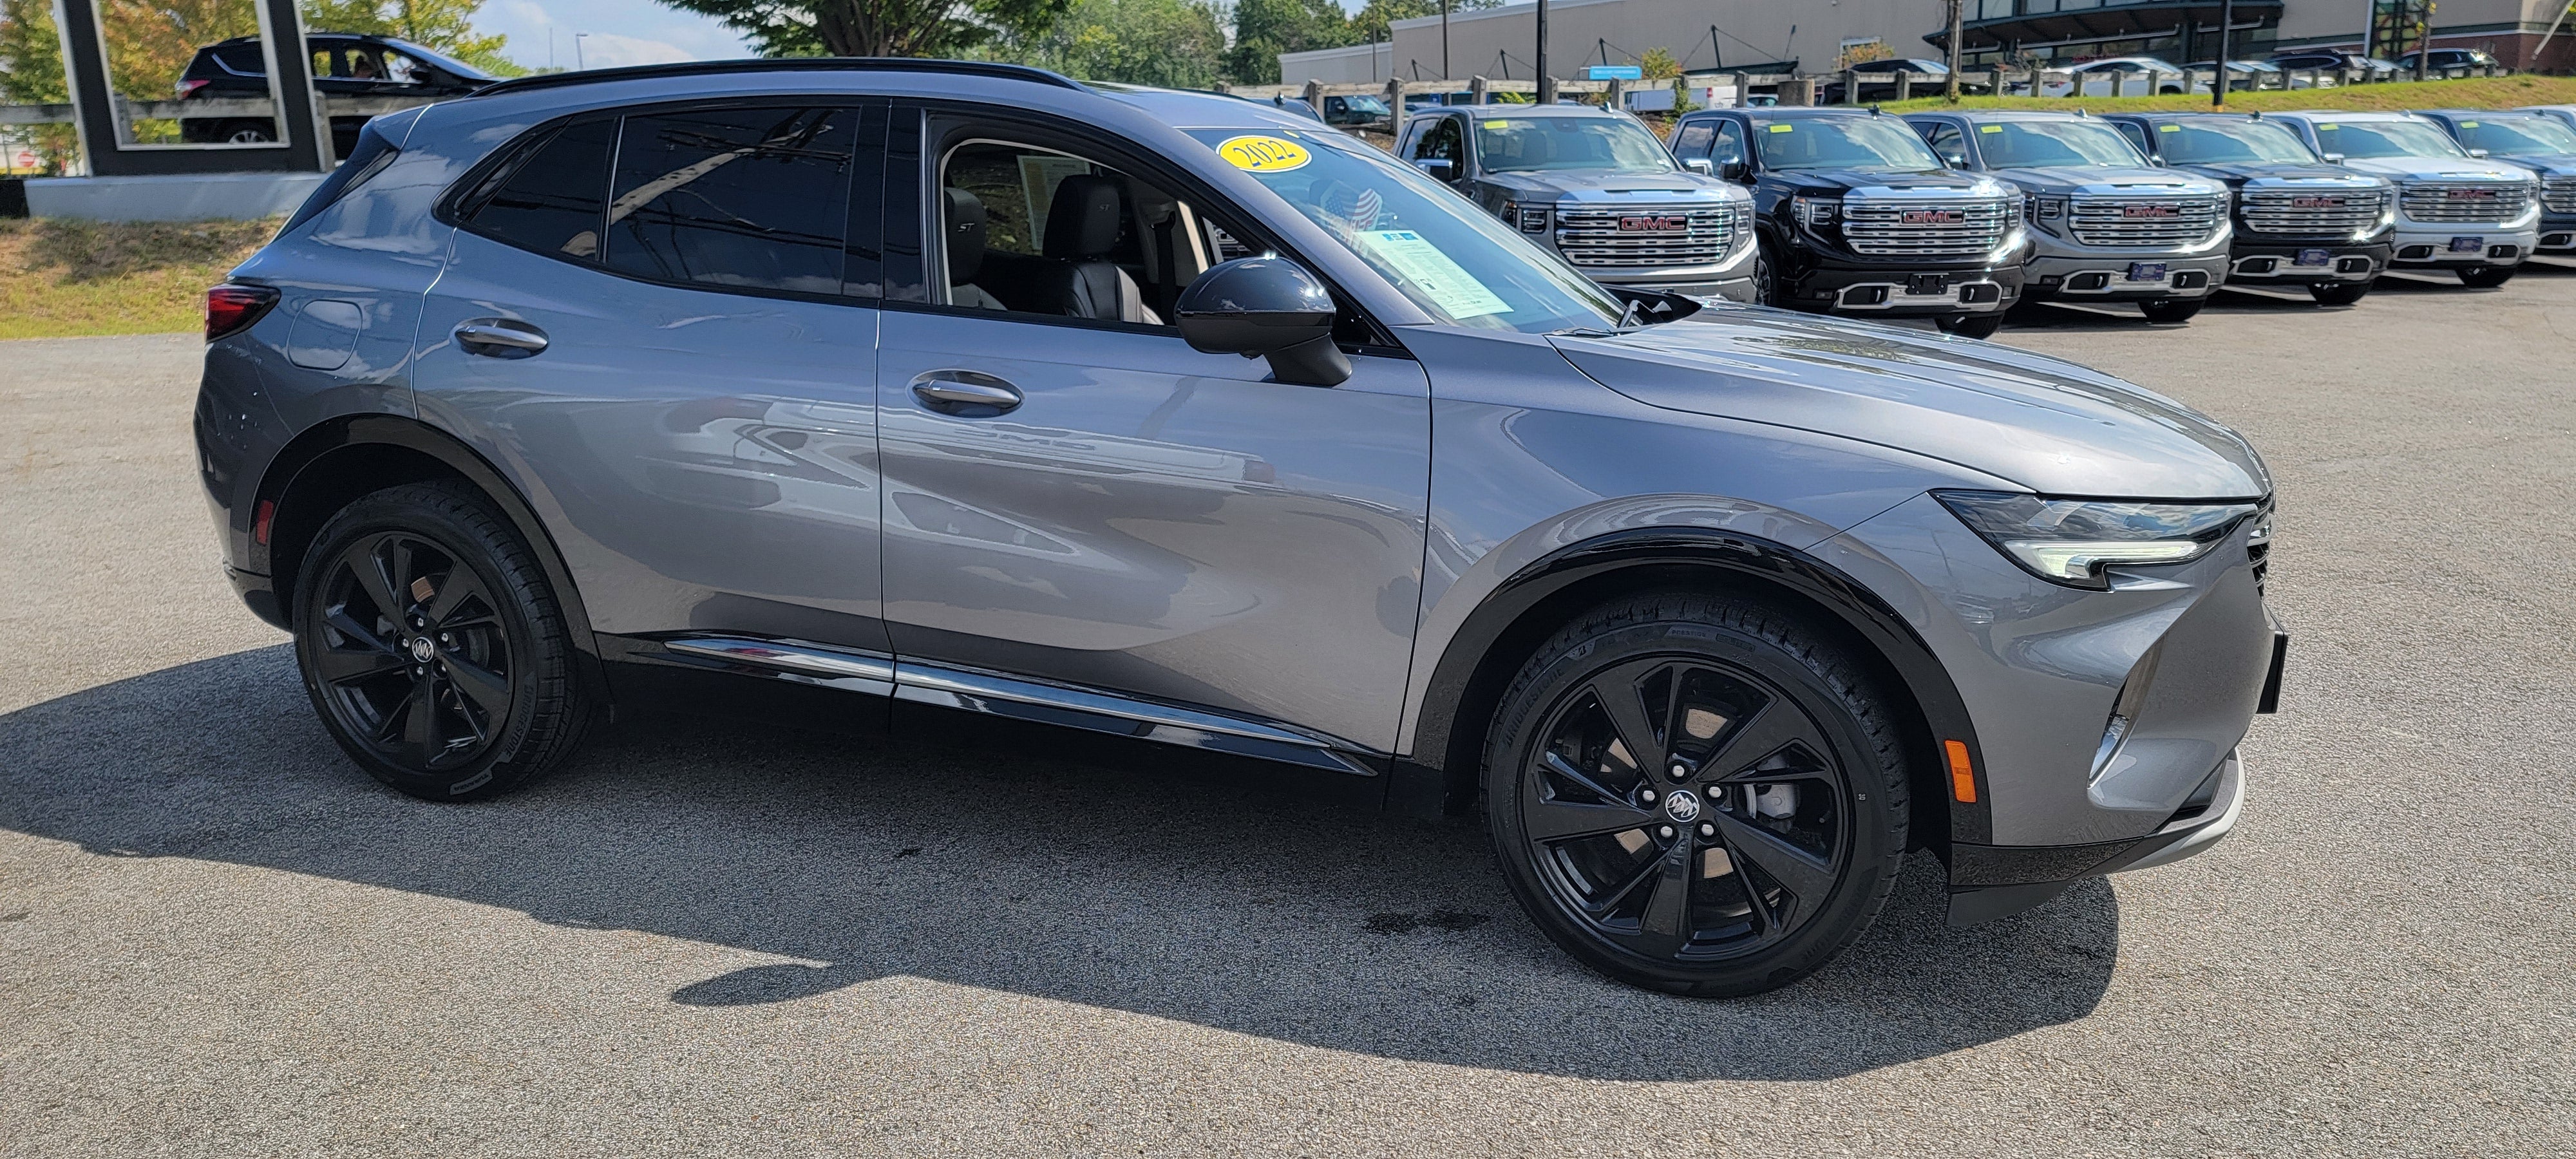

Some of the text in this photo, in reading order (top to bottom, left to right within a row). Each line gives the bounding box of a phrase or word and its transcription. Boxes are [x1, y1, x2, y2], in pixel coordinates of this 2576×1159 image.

[1233, 140, 1296, 167] 2022
[2449, 190, 2496, 200] GMC
[2294, 198, 2344, 208] GMC
[1904, 211, 1963, 223] GMC
[2126, 206, 2179, 217] GMC
[957, 222, 976, 232] ST
[1621, 216, 1686, 230] GMC
[1504, 668, 1566, 748] BRIDGESTONE
[506, 684, 534, 757] BRIDGESTONE
